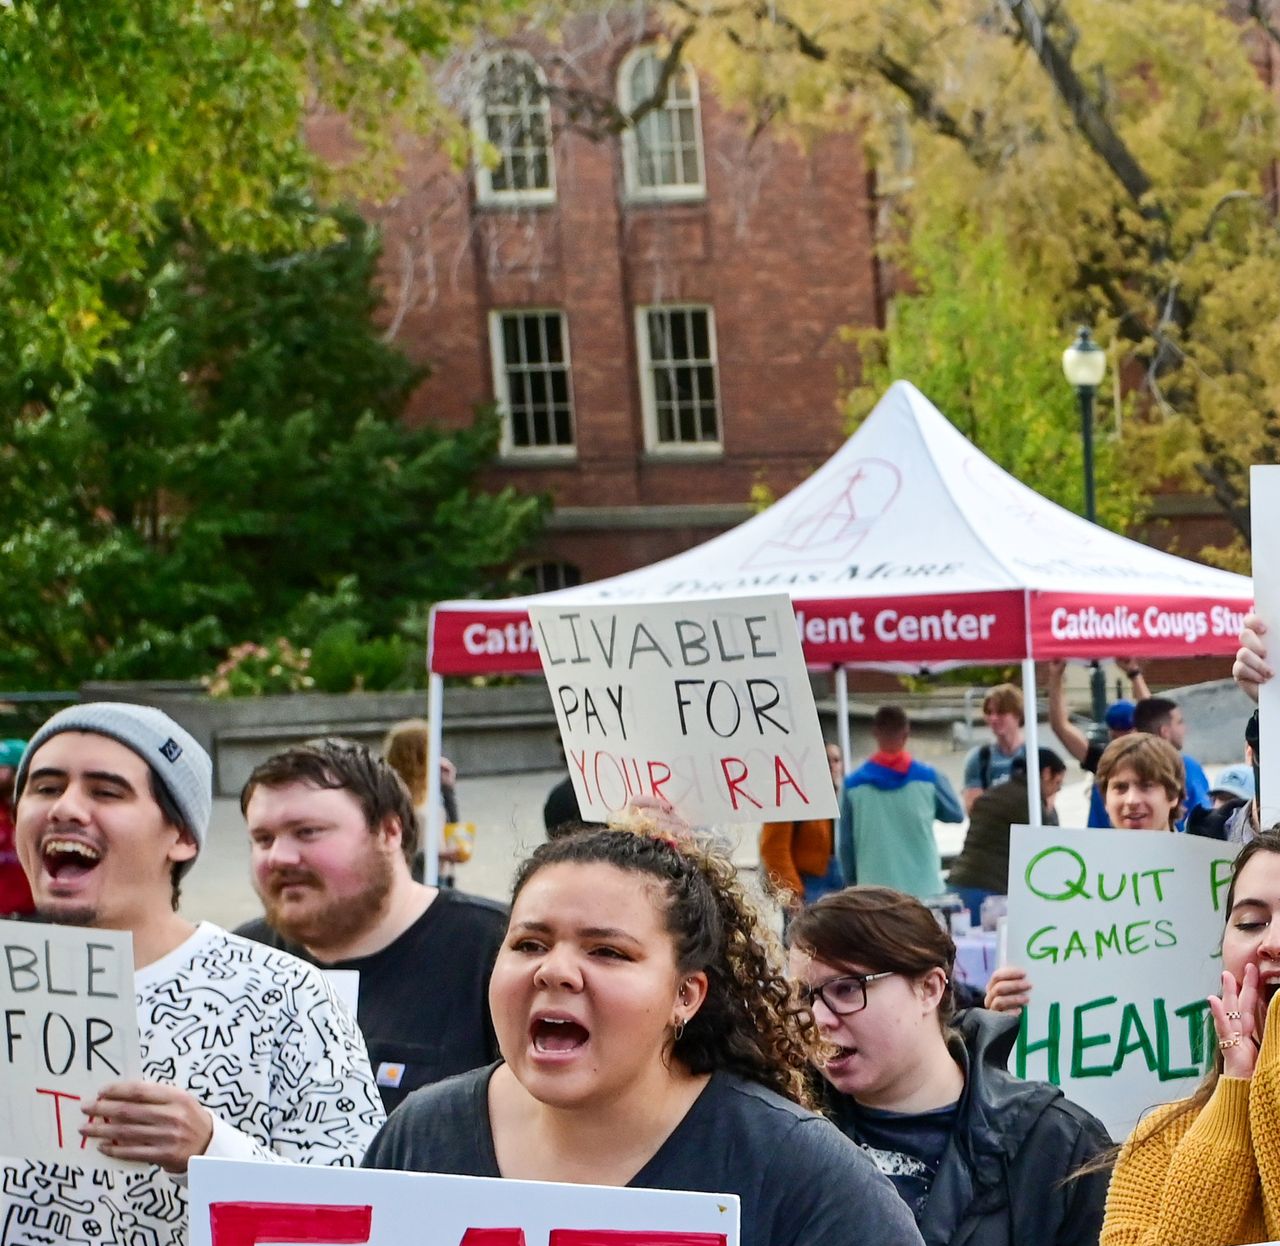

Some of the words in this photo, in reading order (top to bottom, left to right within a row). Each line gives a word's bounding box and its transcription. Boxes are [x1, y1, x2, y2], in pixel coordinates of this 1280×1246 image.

[463, 623, 539, 656] Cath
[874, 608, 997, 641] Center
[538, 613, 776, 669] LIVABLE
[1051, 606, 1141, 640] Catholic
[1143, 605, 1208, 643] Cougs
[1210, 604, 1255, 636] Stu
[558, 685, 628, 740] PAY
[674, 679, 790, 738] FOR
[570, 750, 672, 811] YOUR
[720, 754, 809, 811] RA
[1025, 846, 1175, 907] QUIT
[3, 940, 119, 999] BLE
[1026, 919, 1178, 965] GAMES
[5, 1010, 121, 1076] FOR
[1015, 996, 1215, 1086] HEALT
